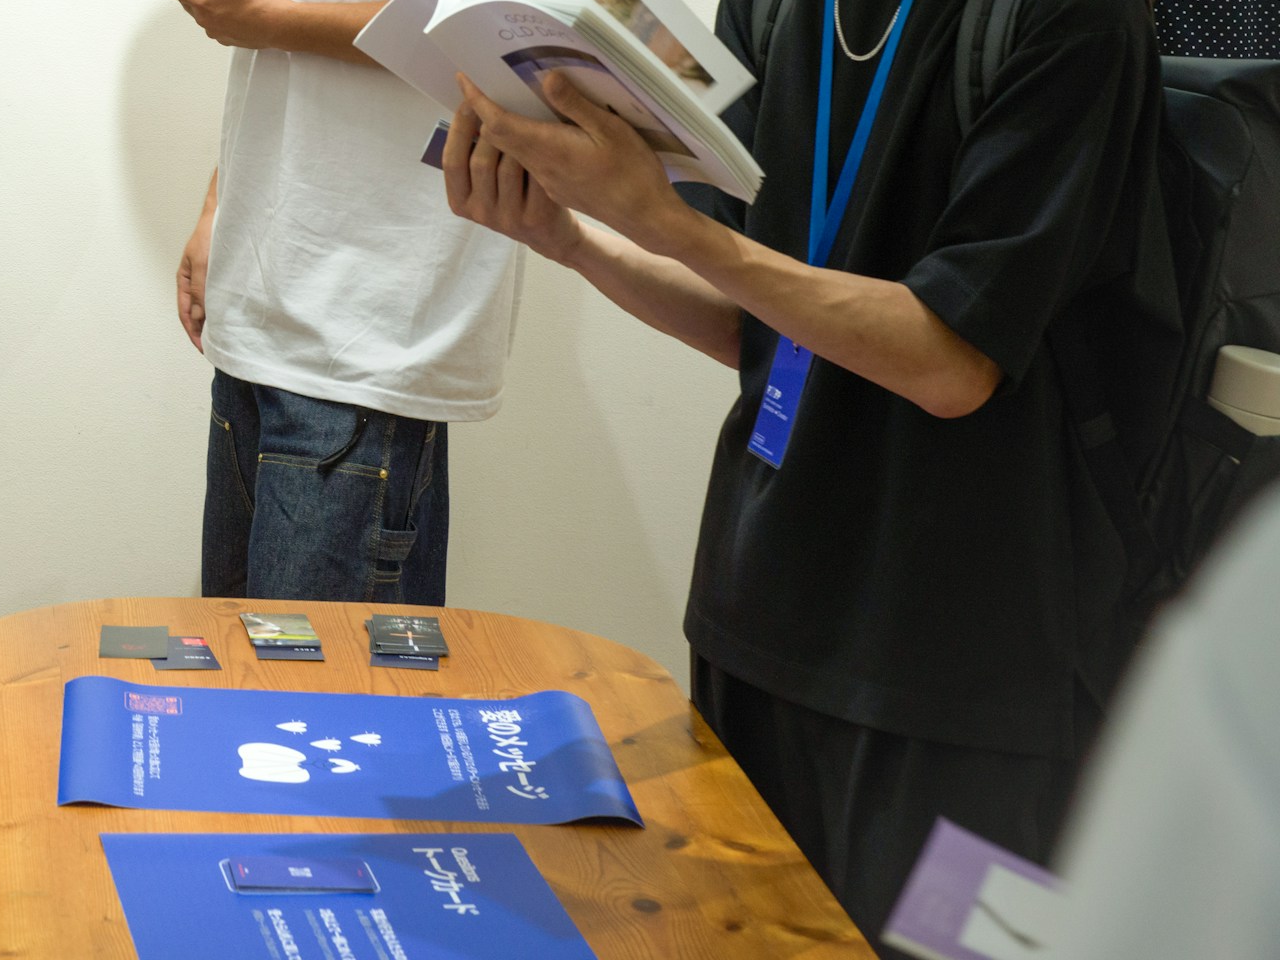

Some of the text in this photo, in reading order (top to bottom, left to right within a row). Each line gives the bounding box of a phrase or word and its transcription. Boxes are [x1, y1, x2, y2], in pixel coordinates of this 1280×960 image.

[498, 26, 534, 41] OLD
[478, 707, 549, 800] 愛のメッセージ
[412, 847, 480, 916] トークカード
